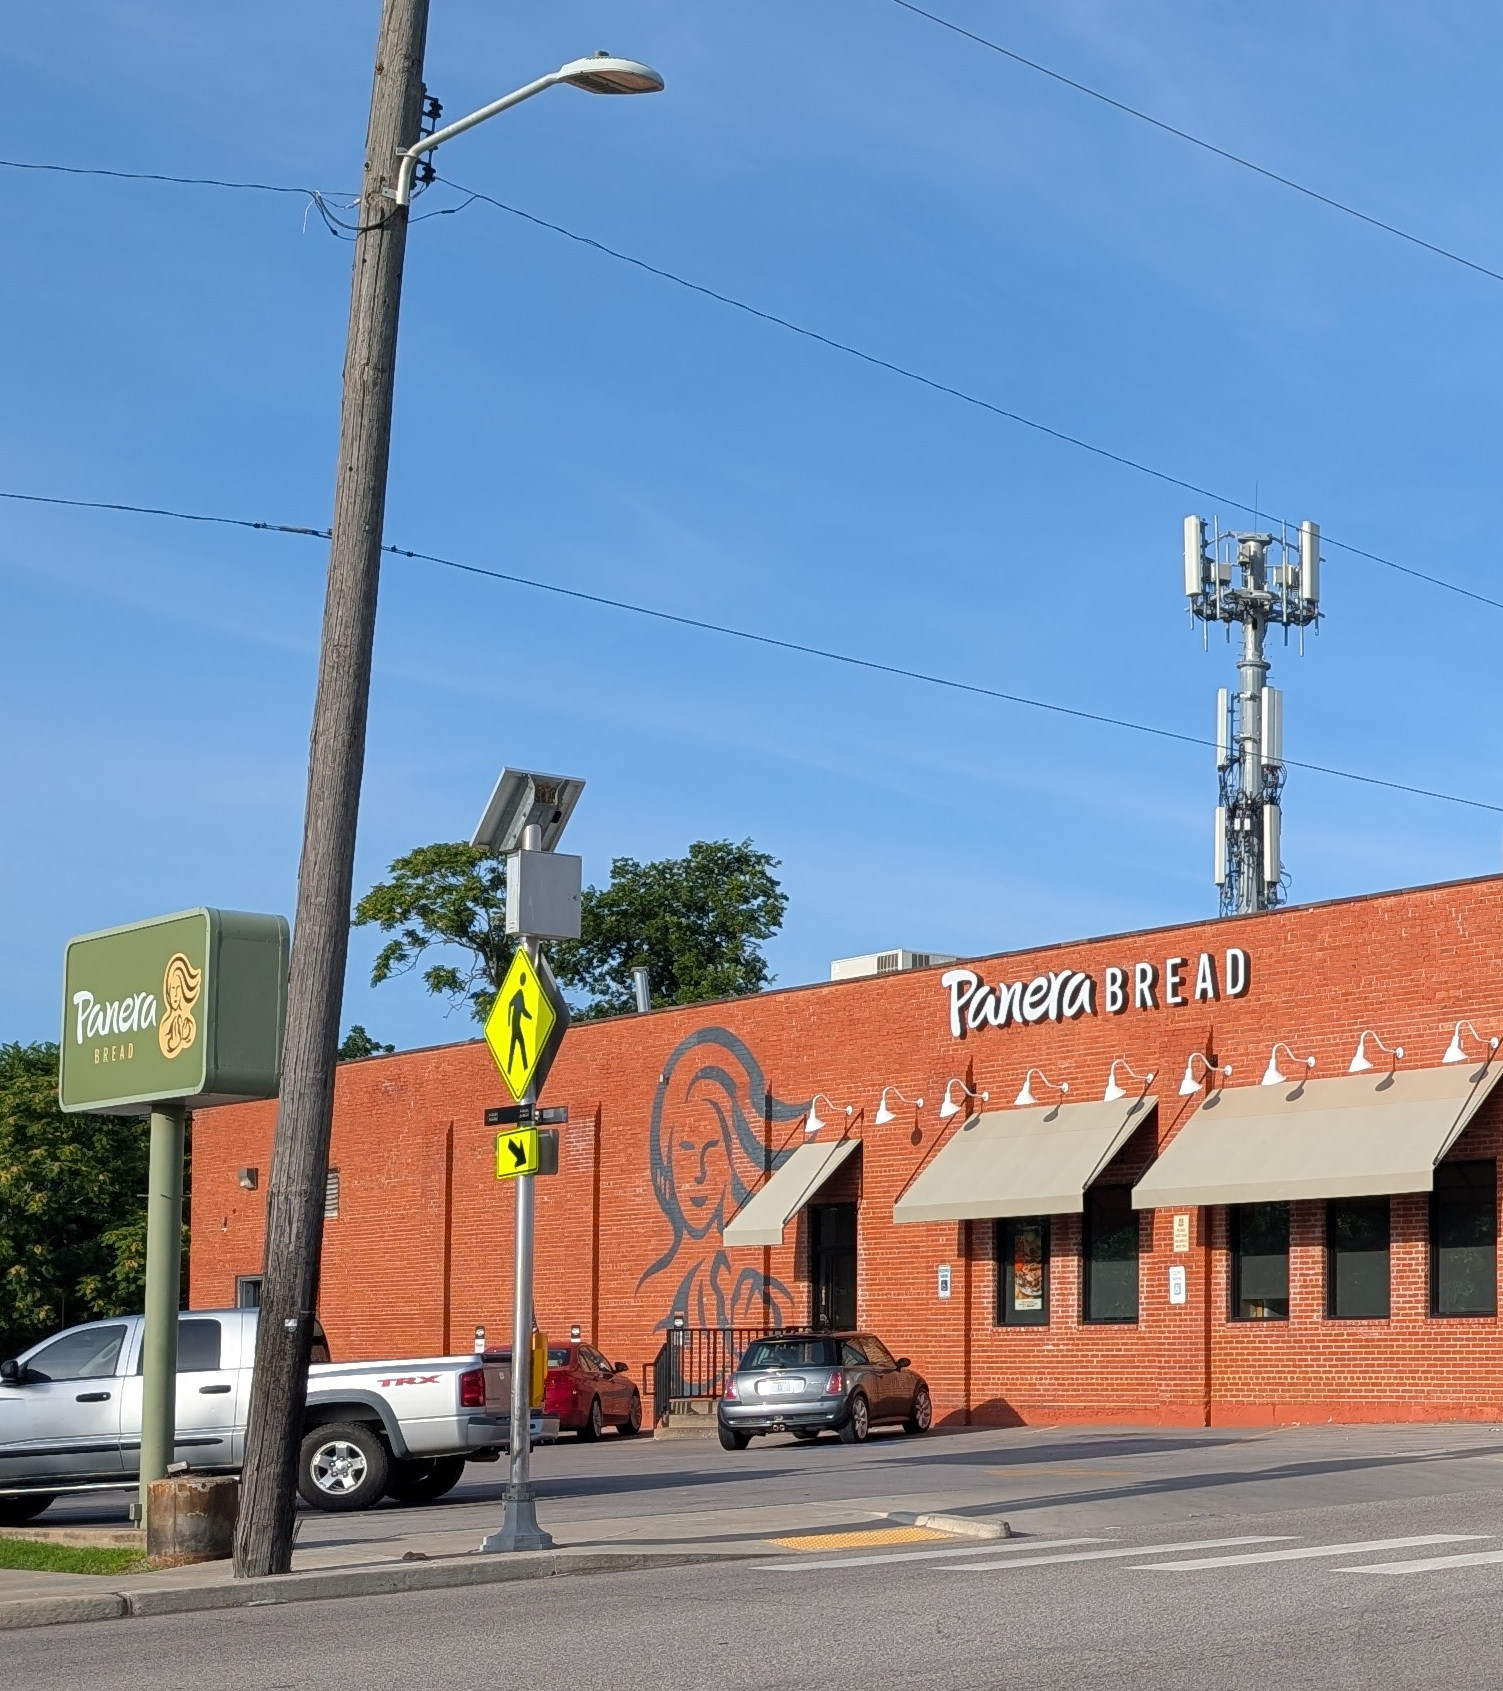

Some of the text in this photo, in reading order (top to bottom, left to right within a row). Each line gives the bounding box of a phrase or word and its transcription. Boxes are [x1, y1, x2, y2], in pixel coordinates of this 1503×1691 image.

[941, 948, 1247, 1037] Panera BREAD
[73, 990, 157, 1045] Panera
[94, 1043, 134, 1064] BREAD
[377, 1374, 443, 1387] TRX
